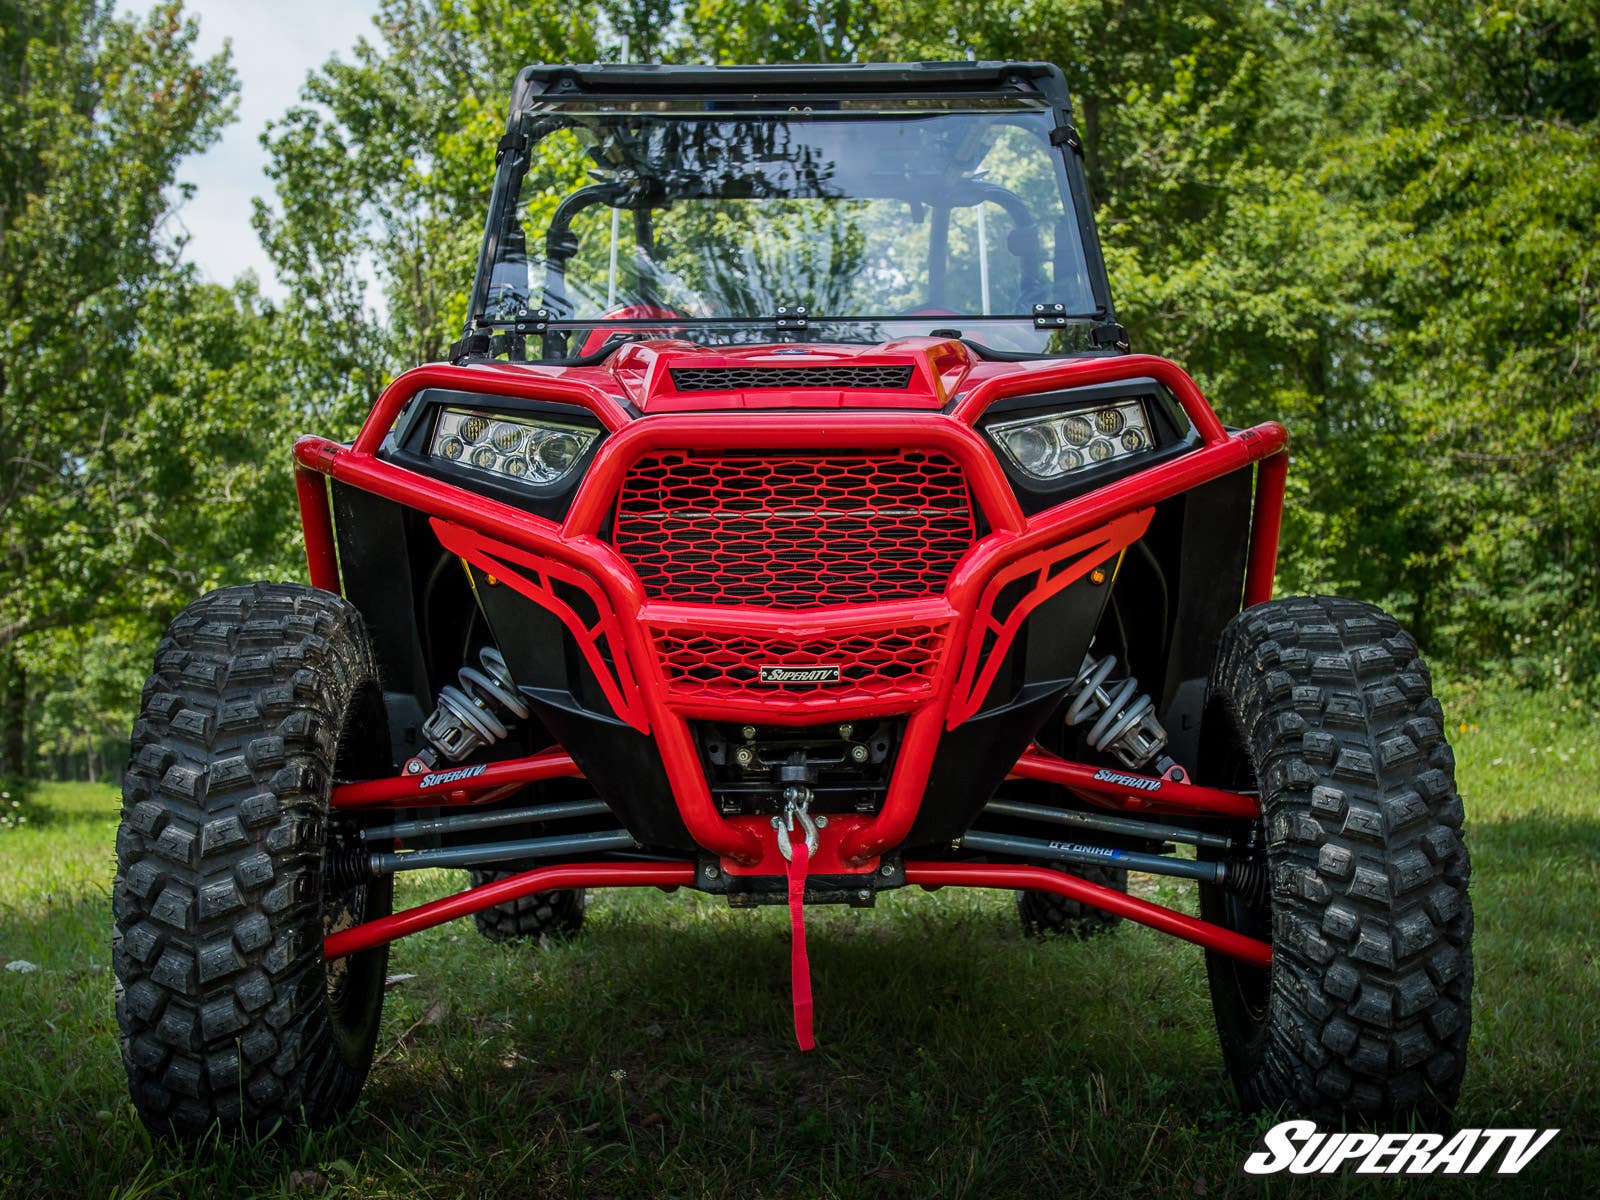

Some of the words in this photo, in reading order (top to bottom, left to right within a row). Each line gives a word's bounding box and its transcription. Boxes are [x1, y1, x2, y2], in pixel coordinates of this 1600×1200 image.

[767, 669, 833, 681] SUPERATV
[419, 764, 487, 789] SUPERATV
[1094, 769, 1161, 791] SUPERATV
[1072, 844, 1115, 856] RHINO
